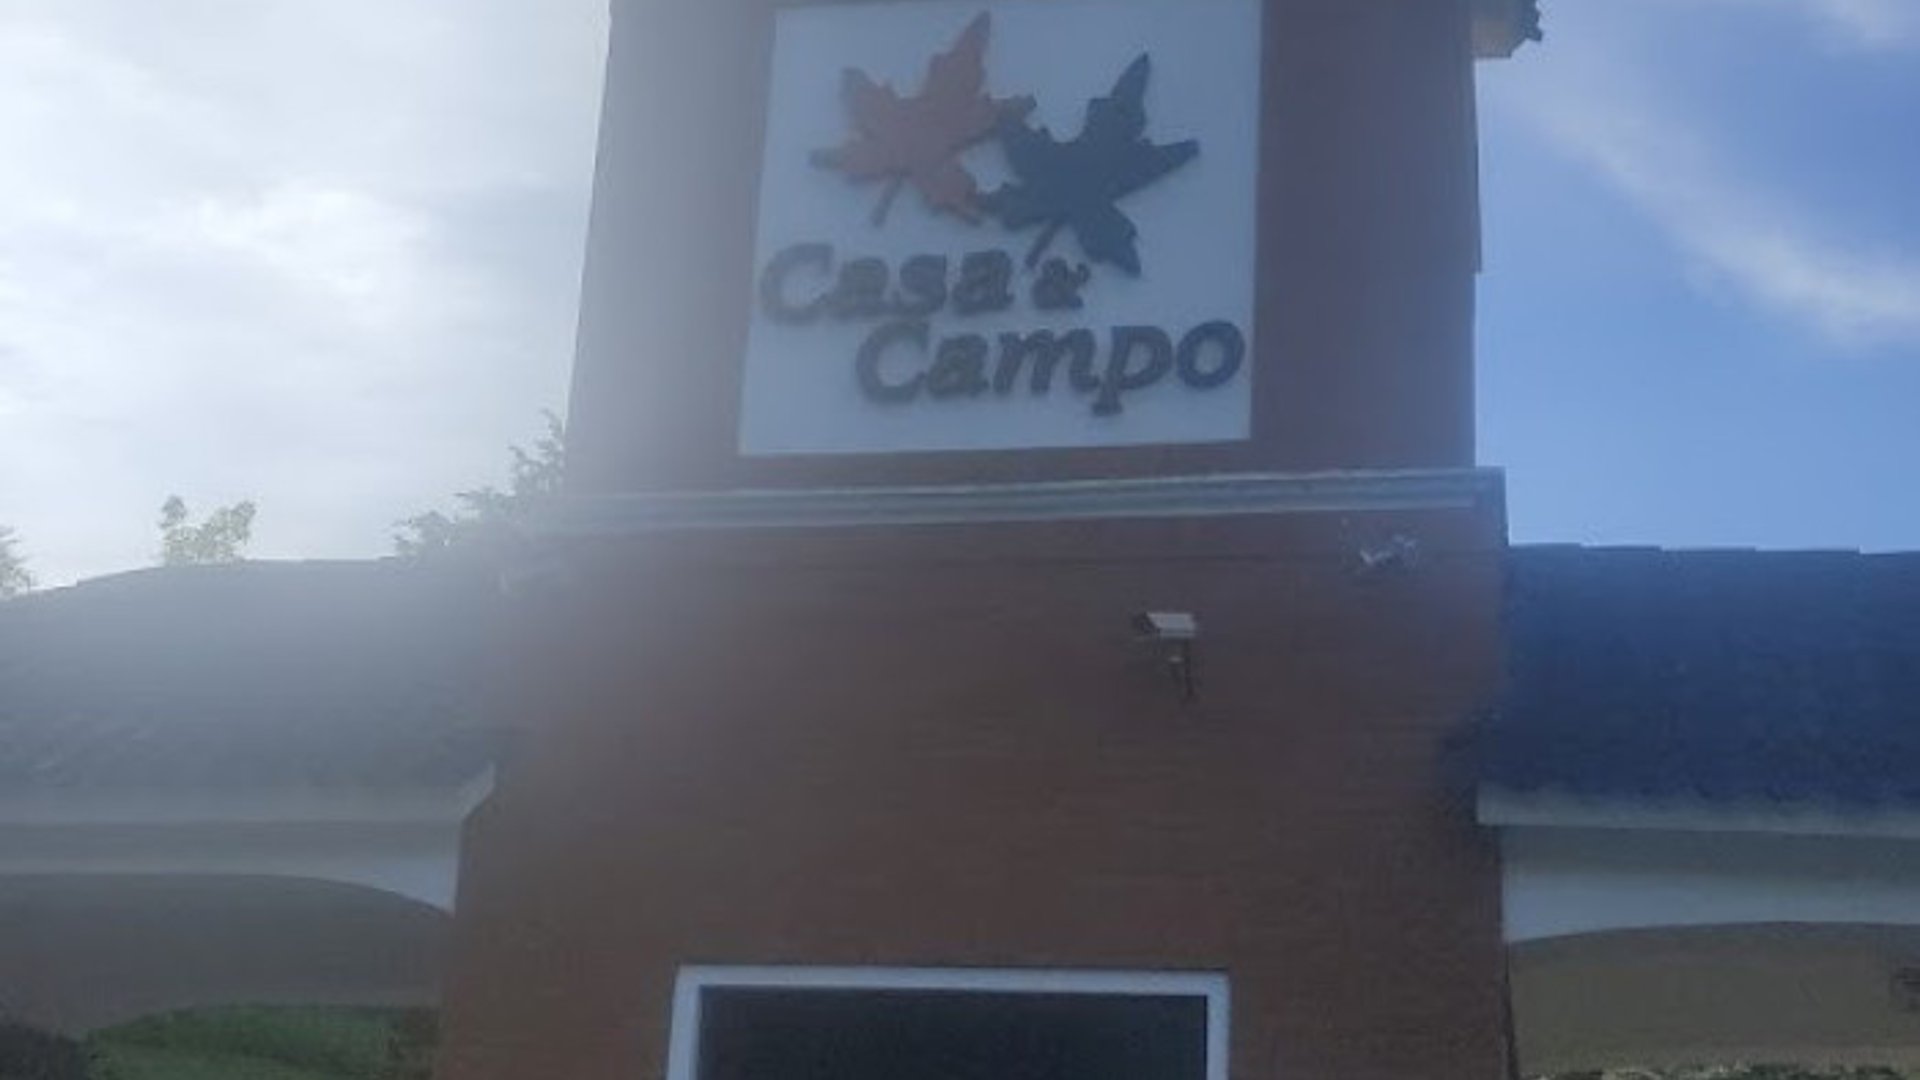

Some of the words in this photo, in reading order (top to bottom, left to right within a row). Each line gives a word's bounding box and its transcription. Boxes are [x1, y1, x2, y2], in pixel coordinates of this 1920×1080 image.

[760, 243, 1014, 324] Casa
[1032, 257, 1090, 310] &
[856, 320, 1246, 417] Campo
